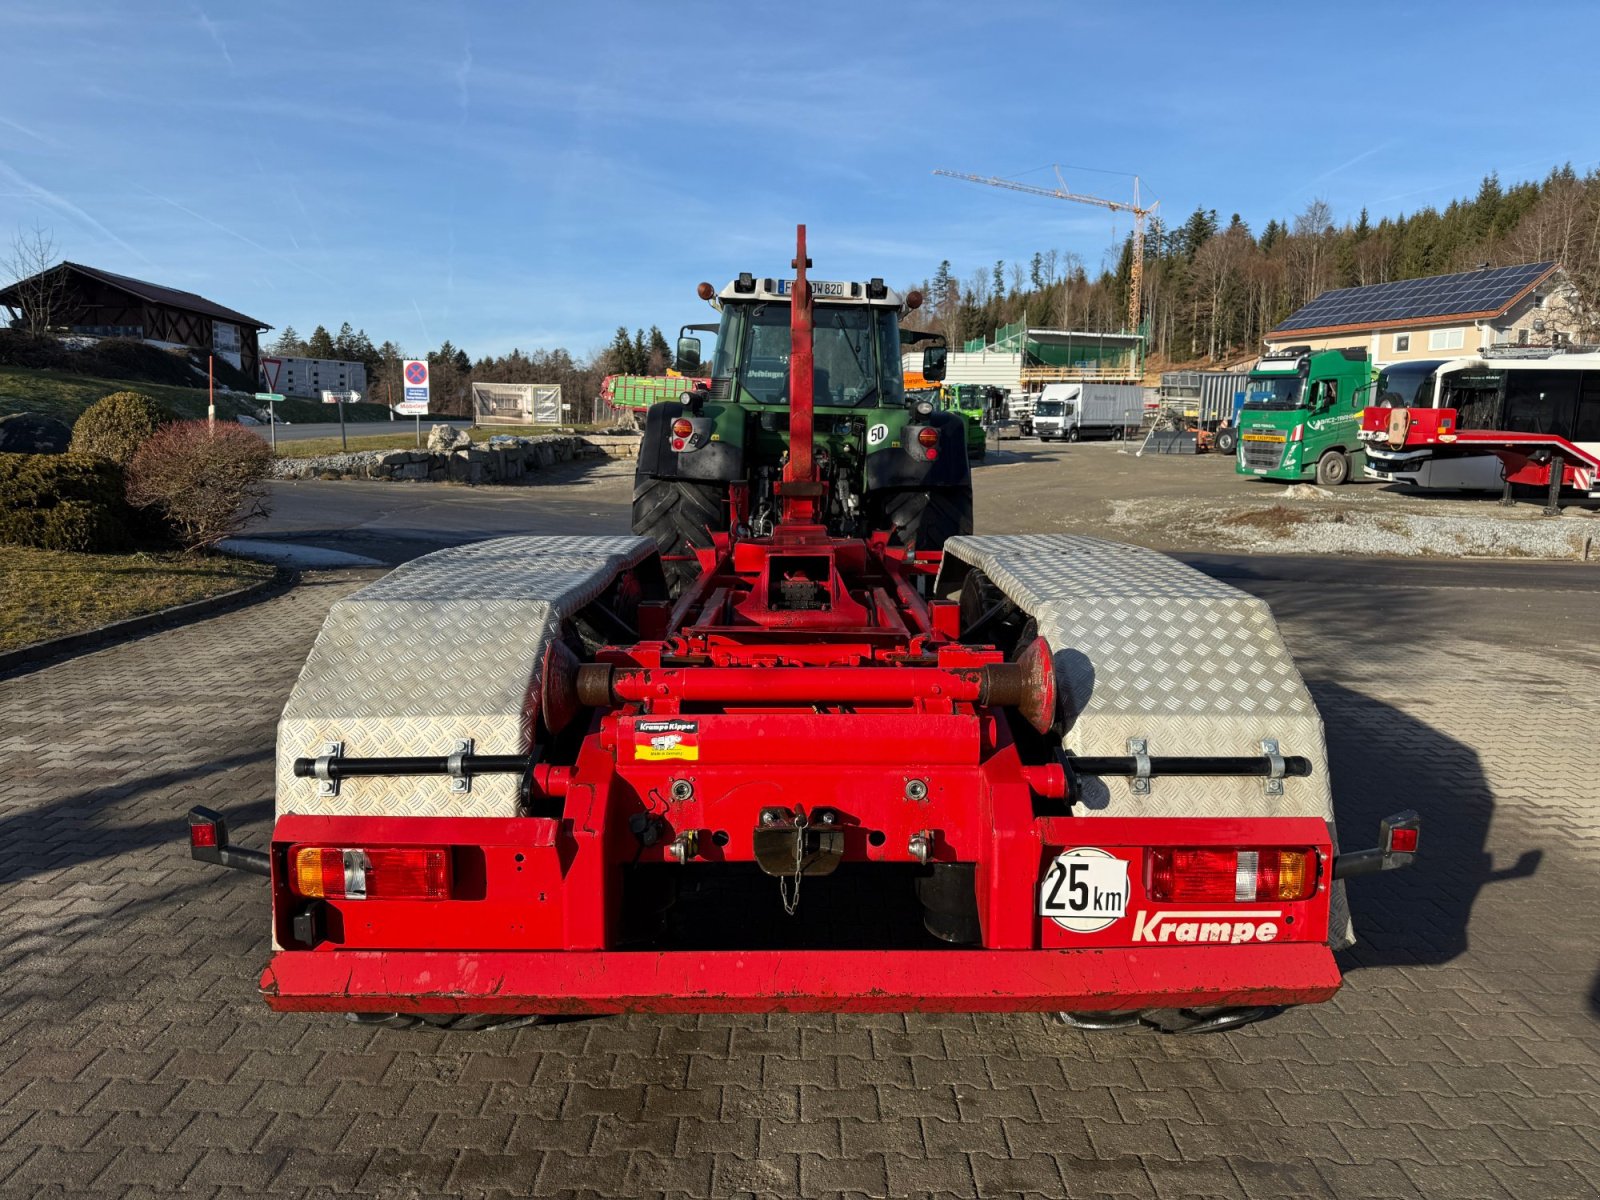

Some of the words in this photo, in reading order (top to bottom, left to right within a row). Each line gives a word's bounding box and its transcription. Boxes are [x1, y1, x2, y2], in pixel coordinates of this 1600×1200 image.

[824, 284, 843, 295] 820
[871, 426, 884, 442] 50
[640, 722, 669, 731] Krampe
[669, 723, 695, 731] Kipper
[1045, 860, 1090, 912] 25
[1093, 886, 1122, 912] km
[1131, 910, 1282, 944] Krampe
